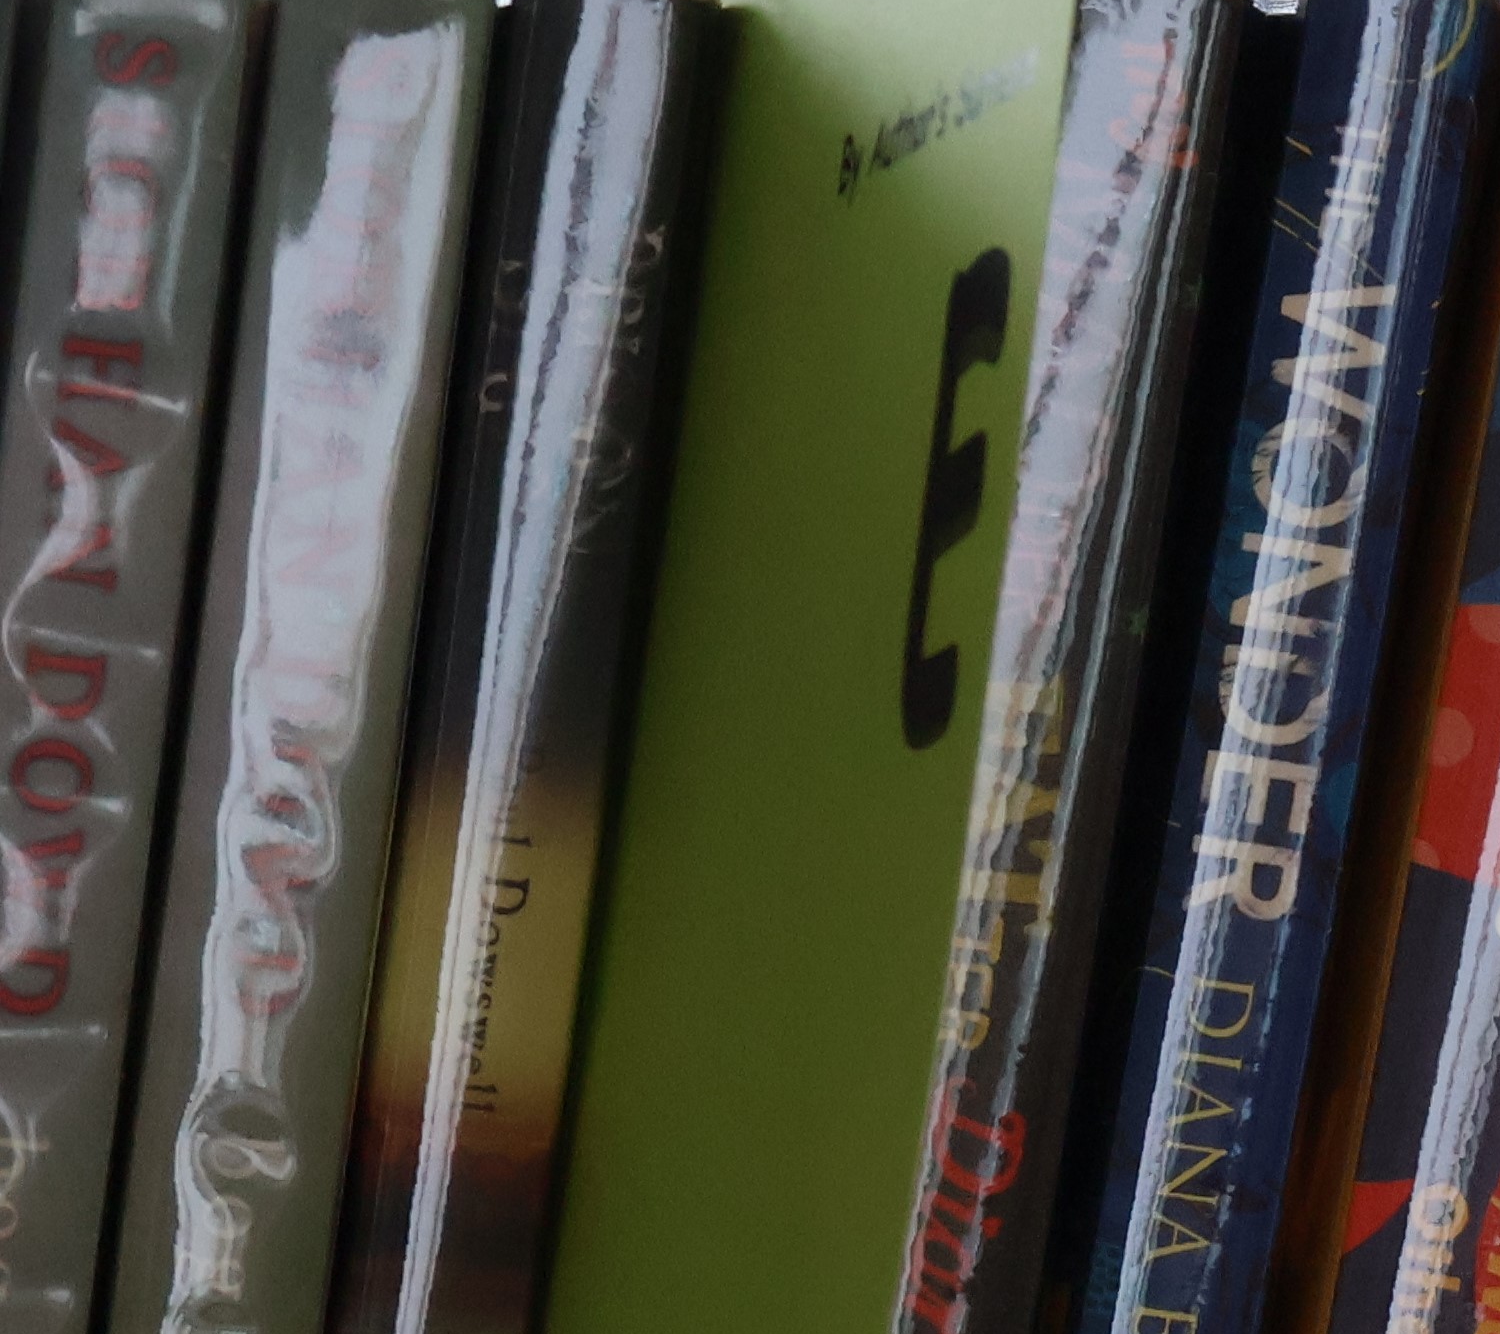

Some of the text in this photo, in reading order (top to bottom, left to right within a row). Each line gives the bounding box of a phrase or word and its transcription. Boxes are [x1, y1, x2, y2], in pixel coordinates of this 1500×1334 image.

[1185, 123, 1397, 924] THE WONDER
[1145, 977, 1255, 1265] DIANA
